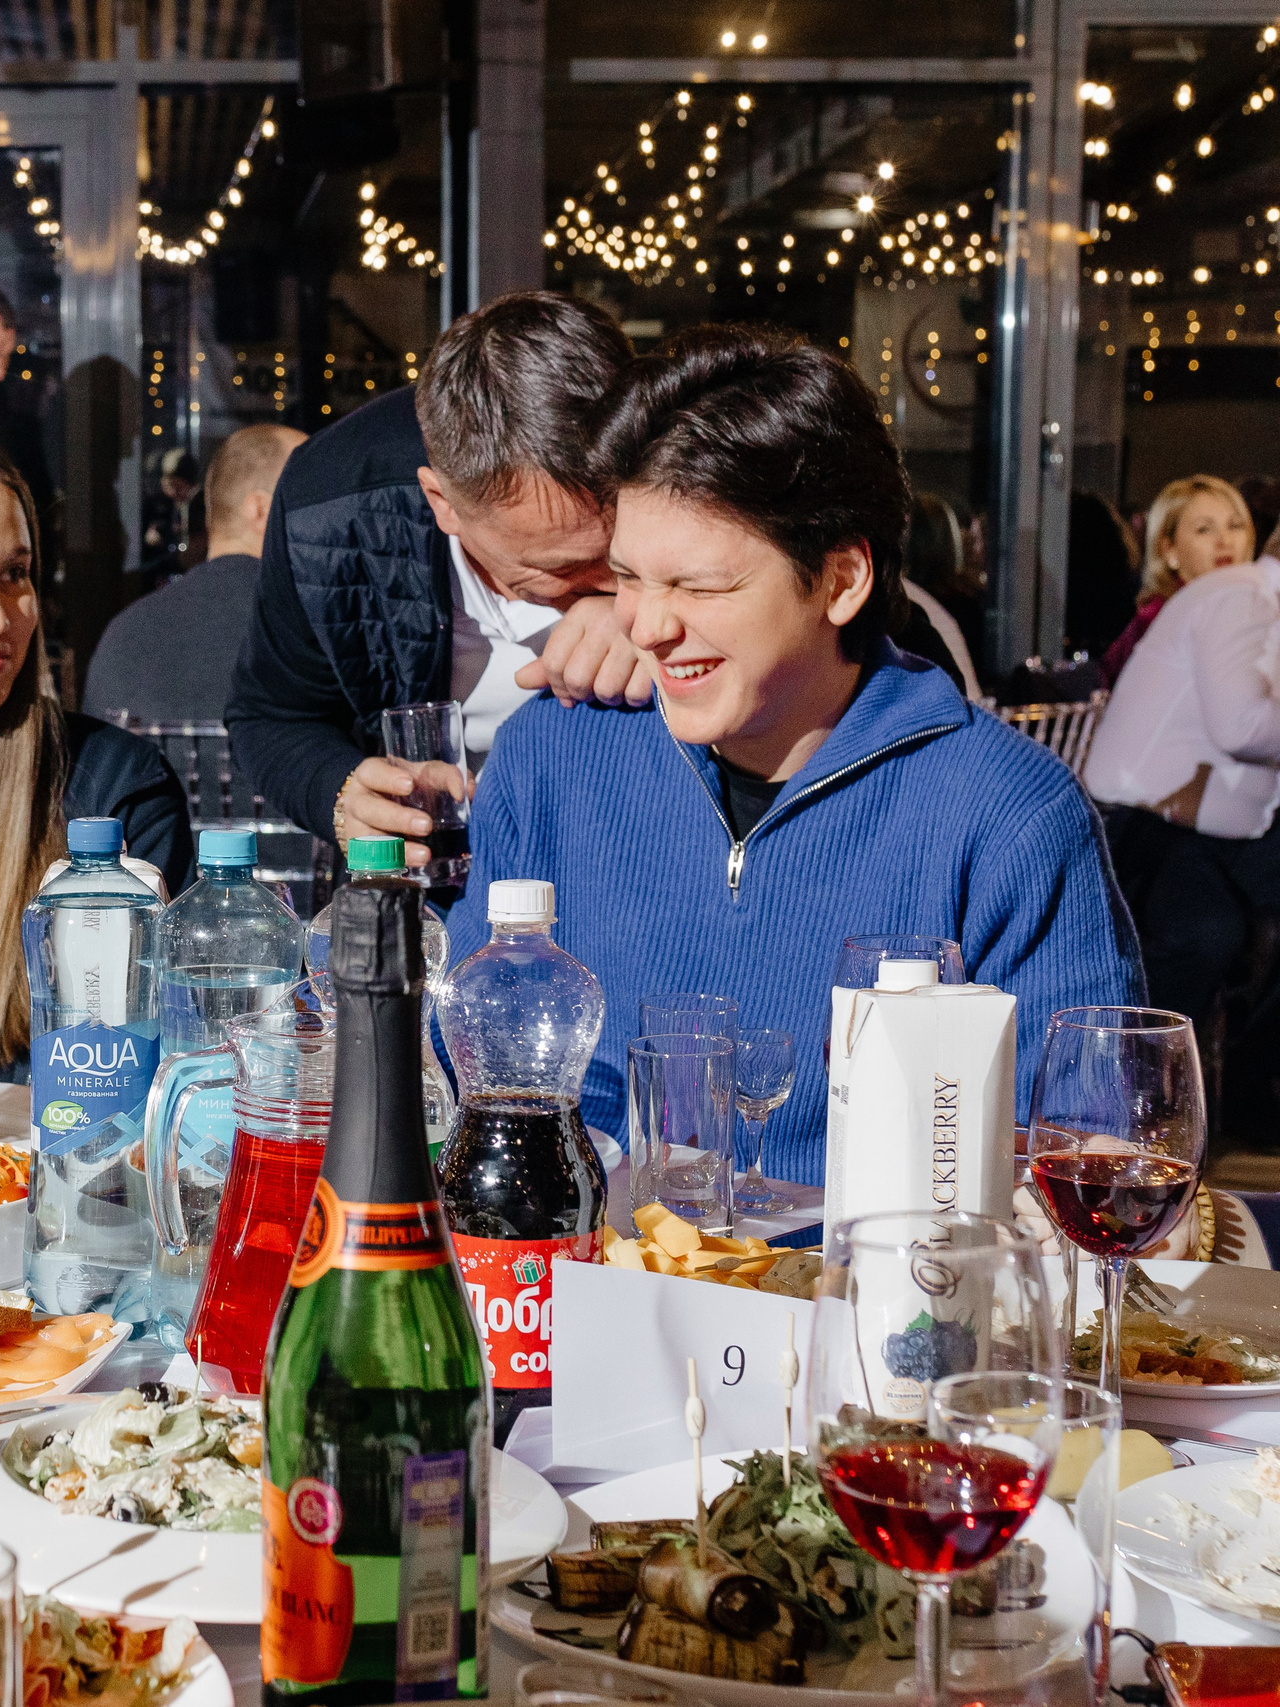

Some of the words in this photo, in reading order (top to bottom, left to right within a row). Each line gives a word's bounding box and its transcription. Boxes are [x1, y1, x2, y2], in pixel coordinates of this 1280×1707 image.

[49, 1037, 139, 1076] AQUA
[57, 1076, 131, 1088] MINERALE
[67, 1090, 118, 1098] газированная
[199, 1098, 233, 1111] МИН
[47, 1107, 91, 1124] 100%
[206, 1113, 236, 1121] негазир
[910, 1072, 961, 1300] BLACKBERRY
[722, 1345, 745, 1386] 9
